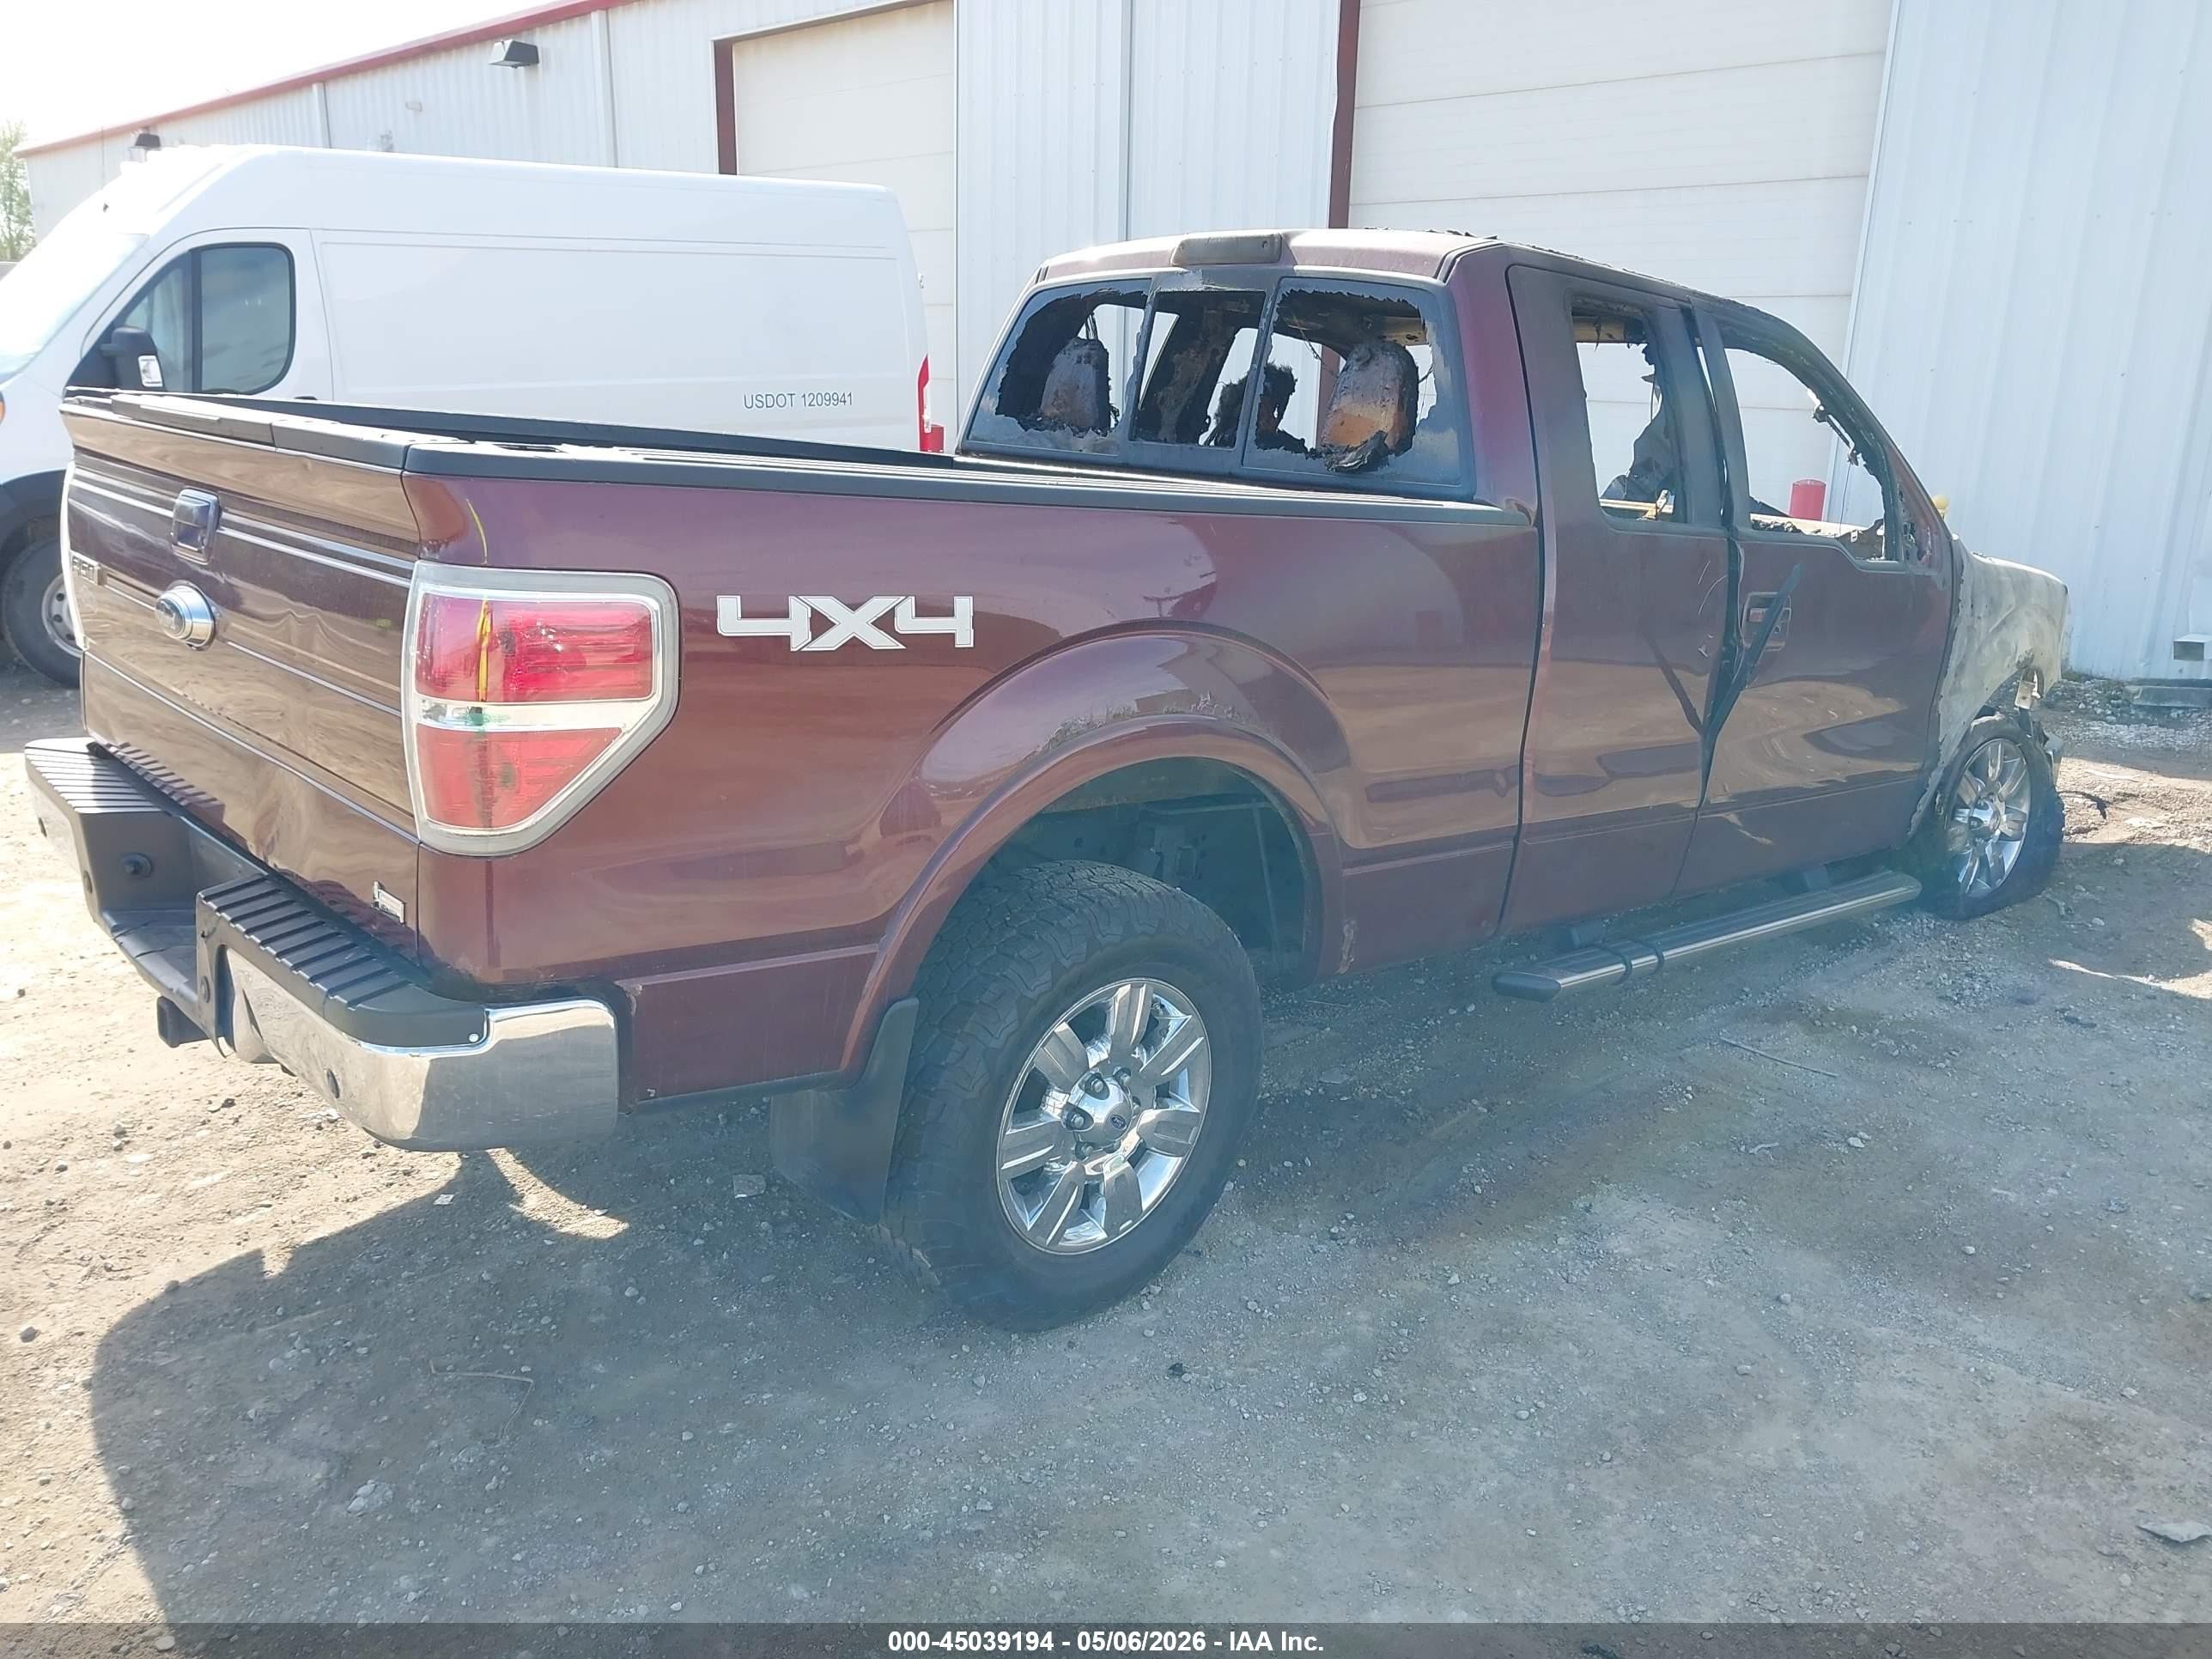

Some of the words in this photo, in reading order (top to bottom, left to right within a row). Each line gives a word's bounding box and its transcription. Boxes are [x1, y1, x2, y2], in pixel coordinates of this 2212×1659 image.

[744, 393, 796, 409] USDOT
[801, 392, 853, 407] 1209941
[716, 595, 974, 651] 4X4
